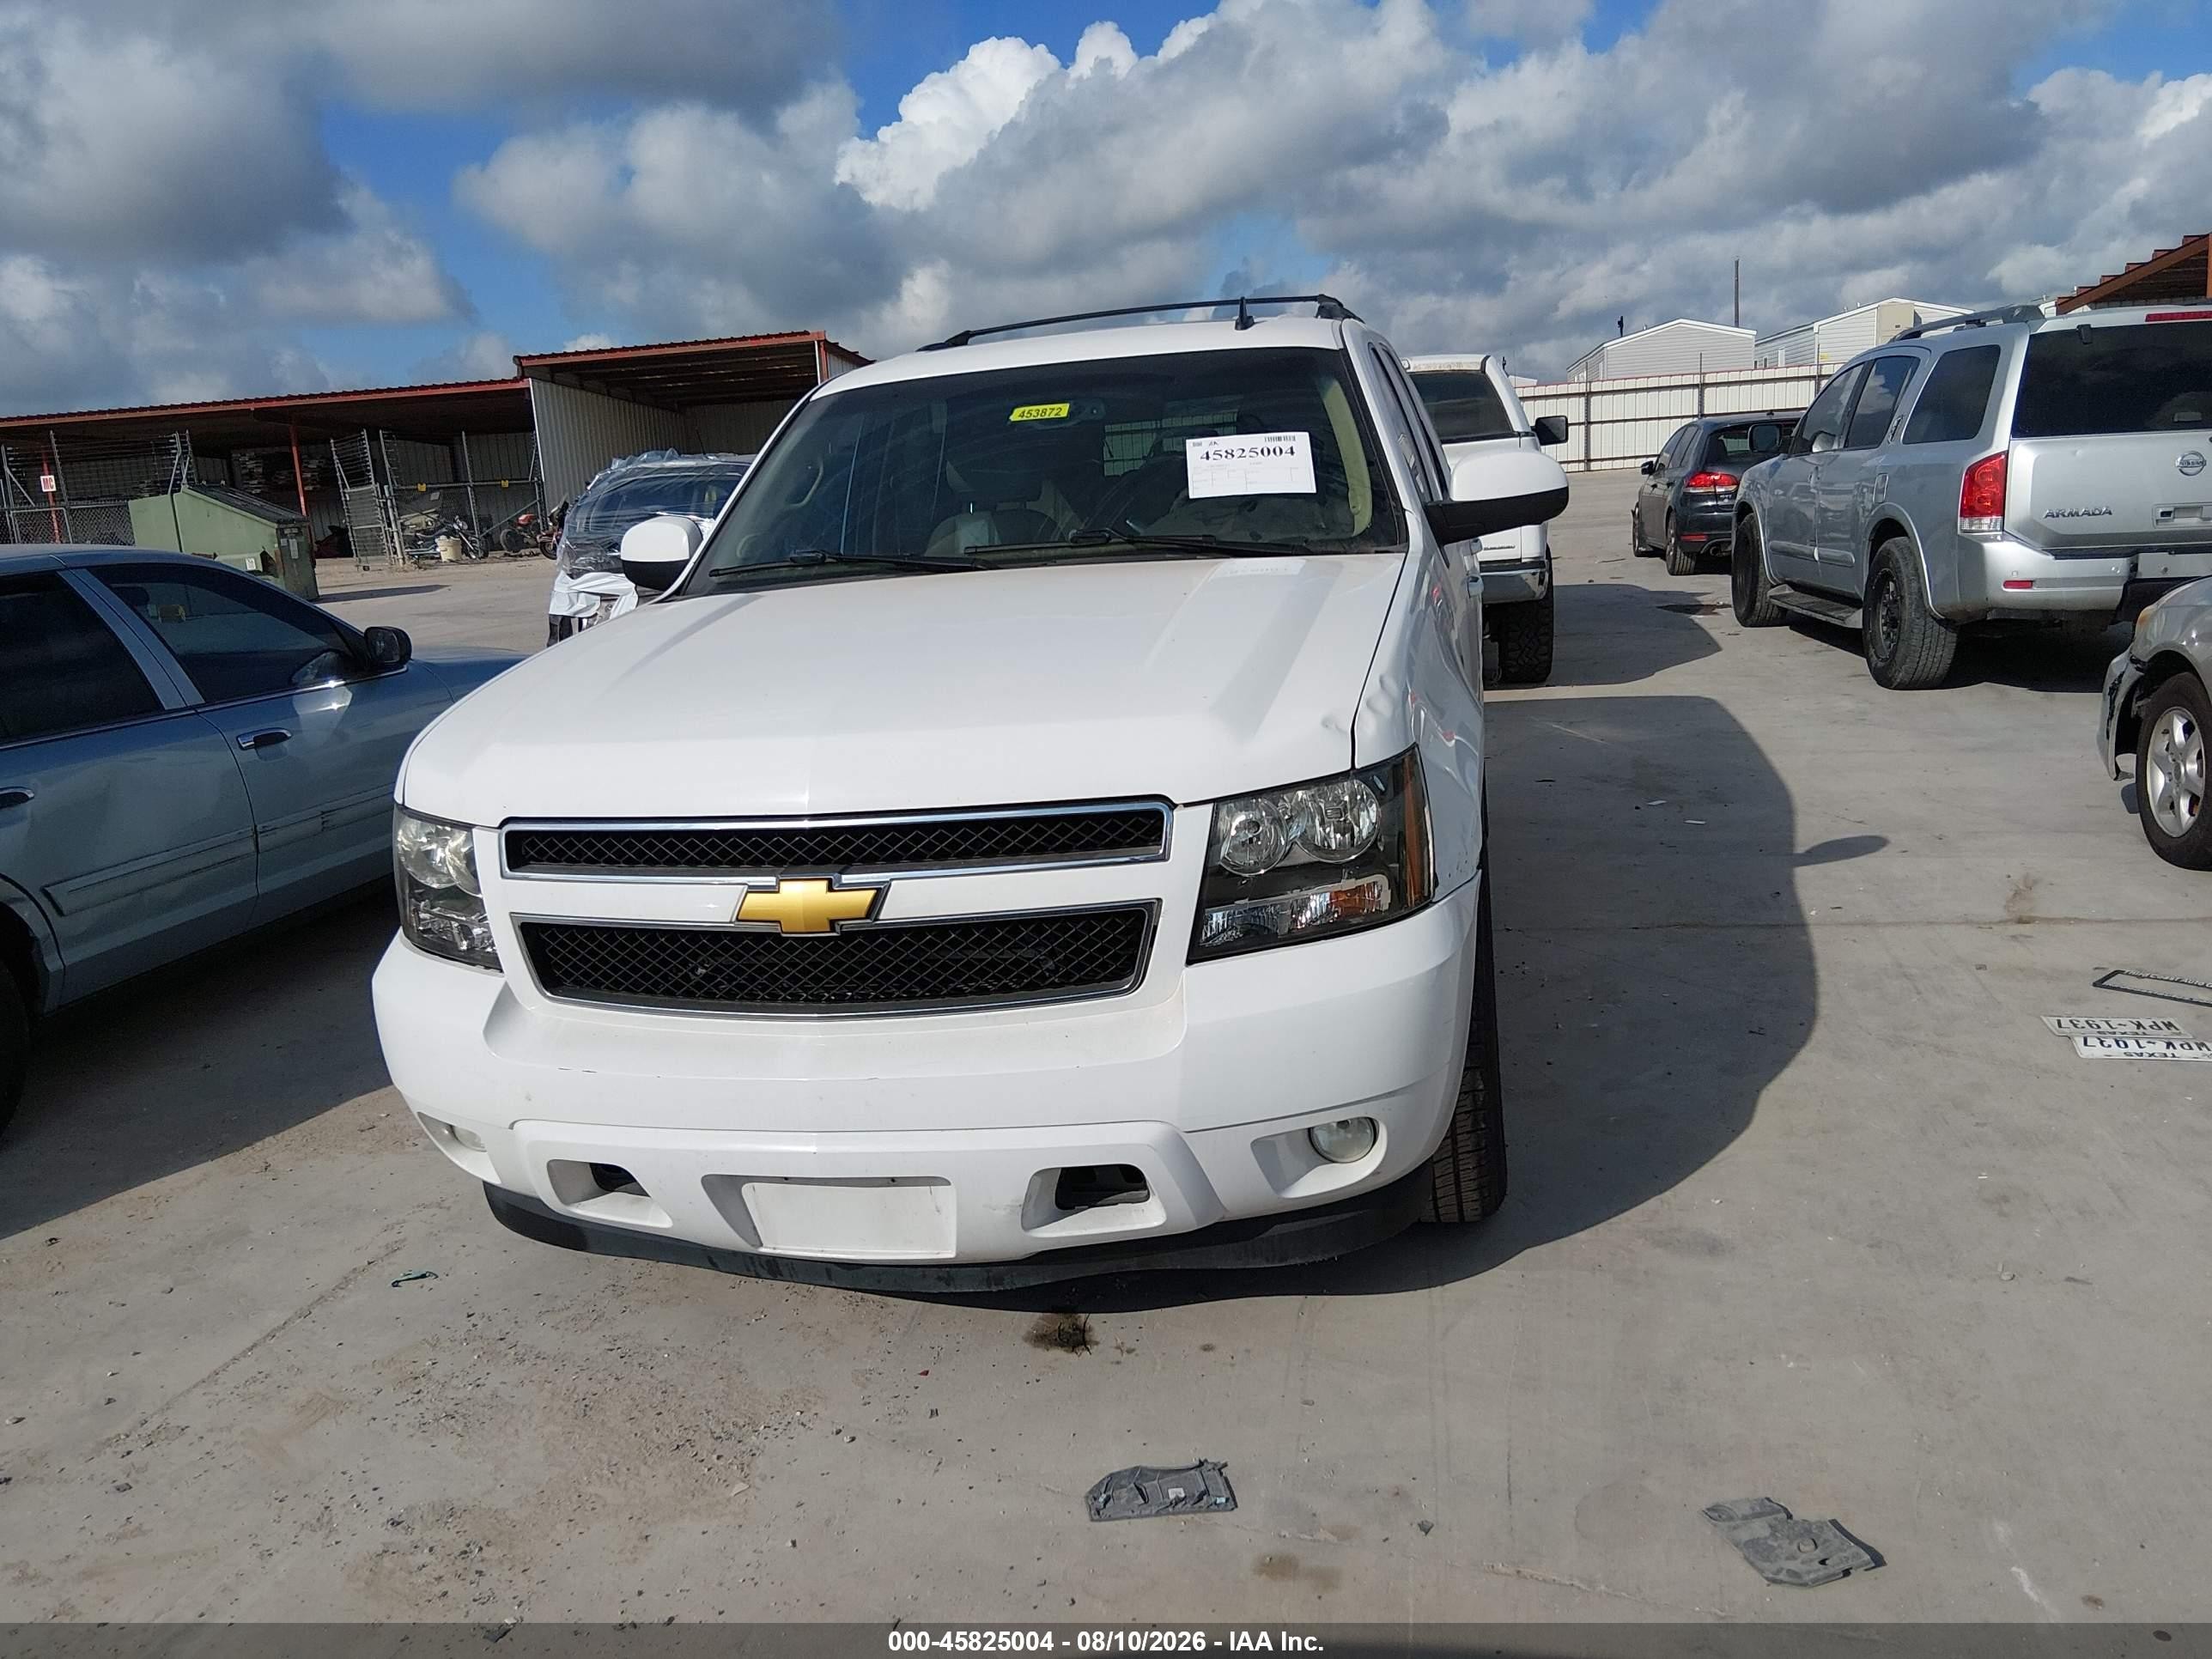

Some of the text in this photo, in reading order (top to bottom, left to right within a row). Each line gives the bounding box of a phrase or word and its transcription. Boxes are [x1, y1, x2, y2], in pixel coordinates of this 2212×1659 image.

[1018, 407, 1062, 418] 453872
[1200, 446, 1296, 461] 45825004
[42, 477, 55, 490] MC
[2044, 506, 2113, 519] ARMADA
